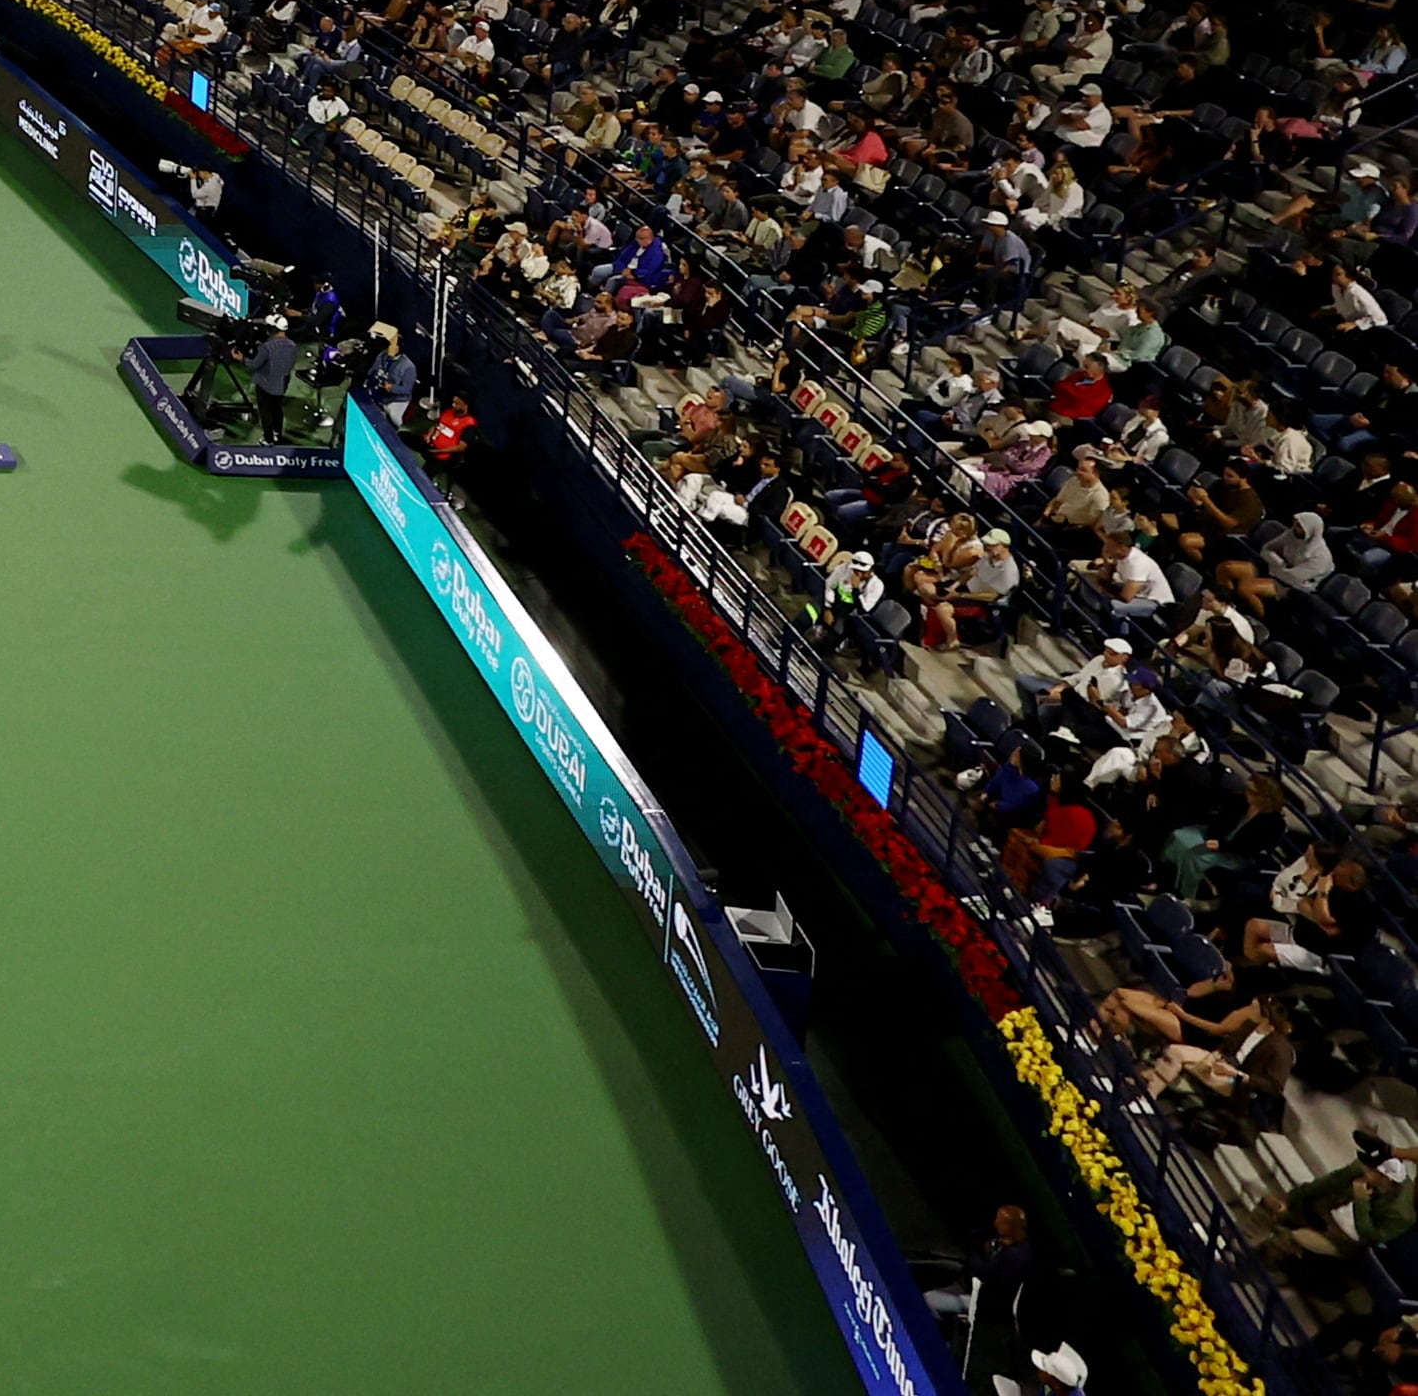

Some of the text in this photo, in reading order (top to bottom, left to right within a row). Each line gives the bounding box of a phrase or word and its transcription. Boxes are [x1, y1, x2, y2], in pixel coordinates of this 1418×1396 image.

[234, 454, 340, 469] Dubai Duty Free
[452, 558, 502, 653] Dubai
[452, 592, 500, 672] Duty Free
[536, 698, 587, 793] DUBAI
[620, 843, 665, 927] Duty Free
[621, 815, 667, 911] Dubai
[733, 1074, 802, 1214] GREY GOOSE
